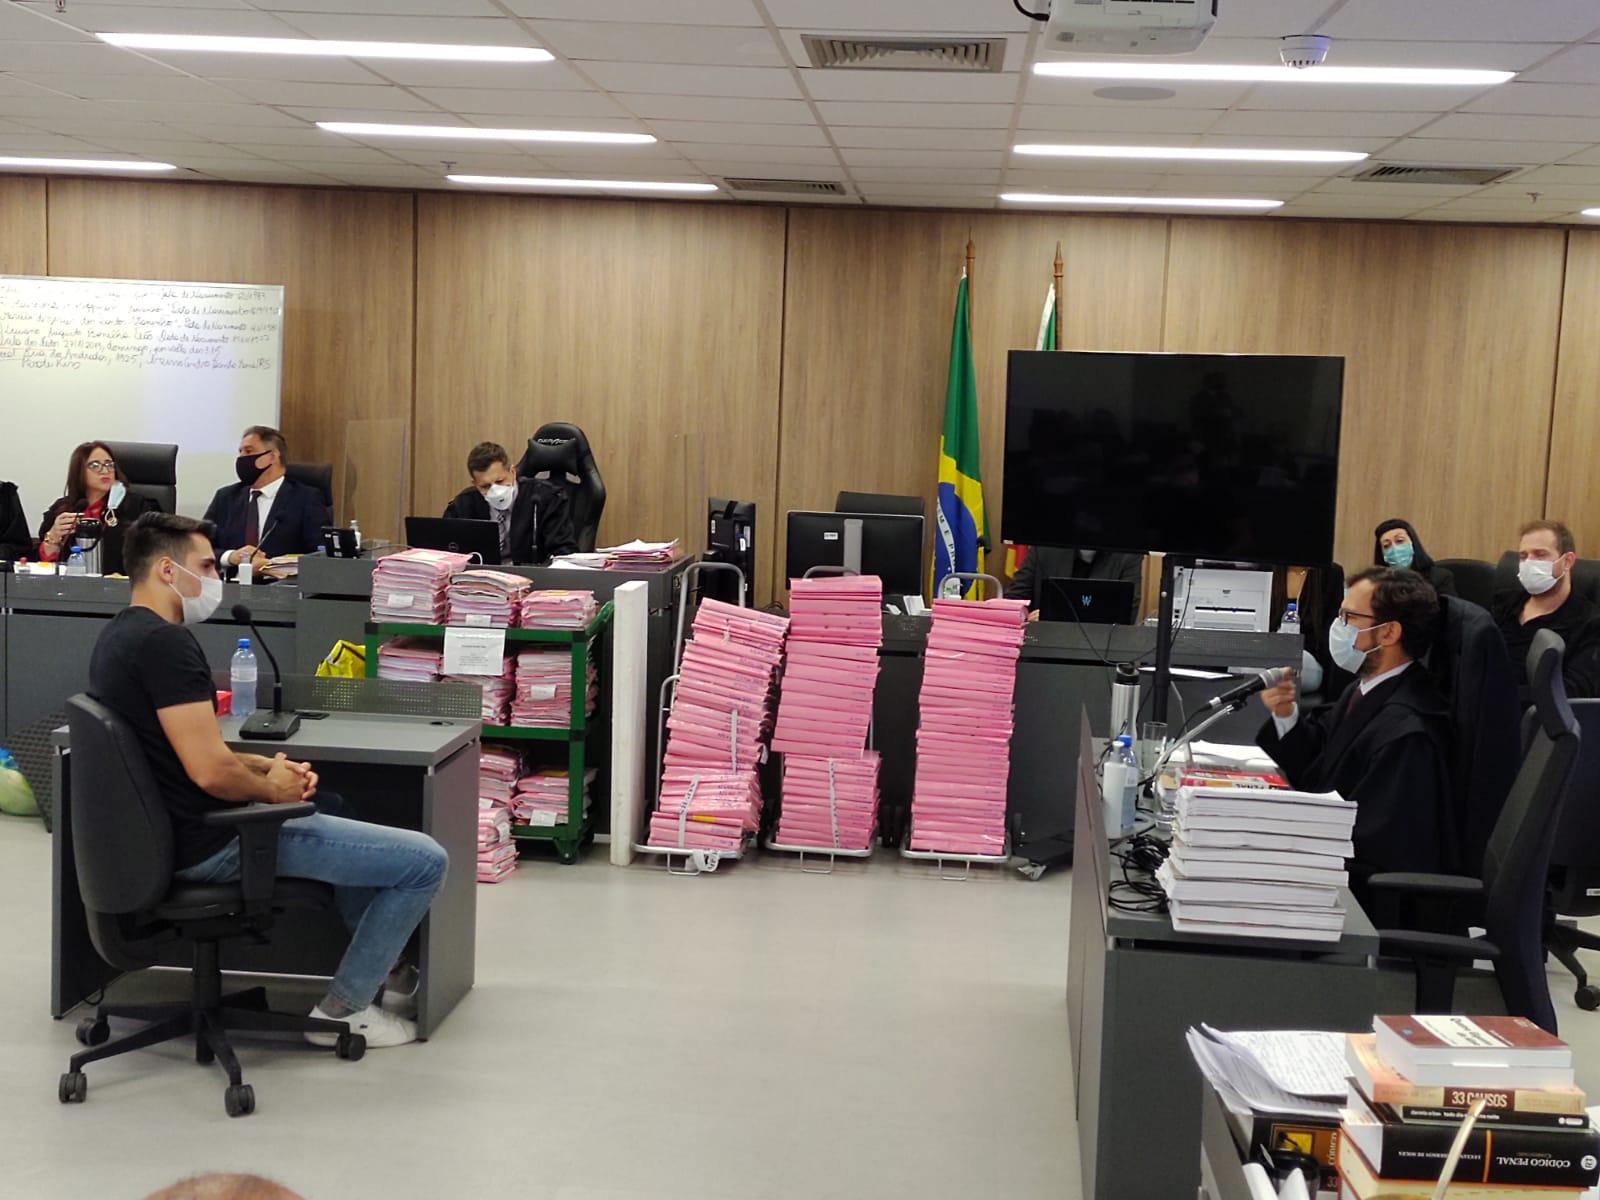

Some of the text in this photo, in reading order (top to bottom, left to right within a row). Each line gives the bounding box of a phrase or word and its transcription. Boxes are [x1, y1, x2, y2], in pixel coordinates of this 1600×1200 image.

[1451, 1091, 1465, 1105] 33
[1496, 1157, 1571, 1168] CÓDIGO PENAL
